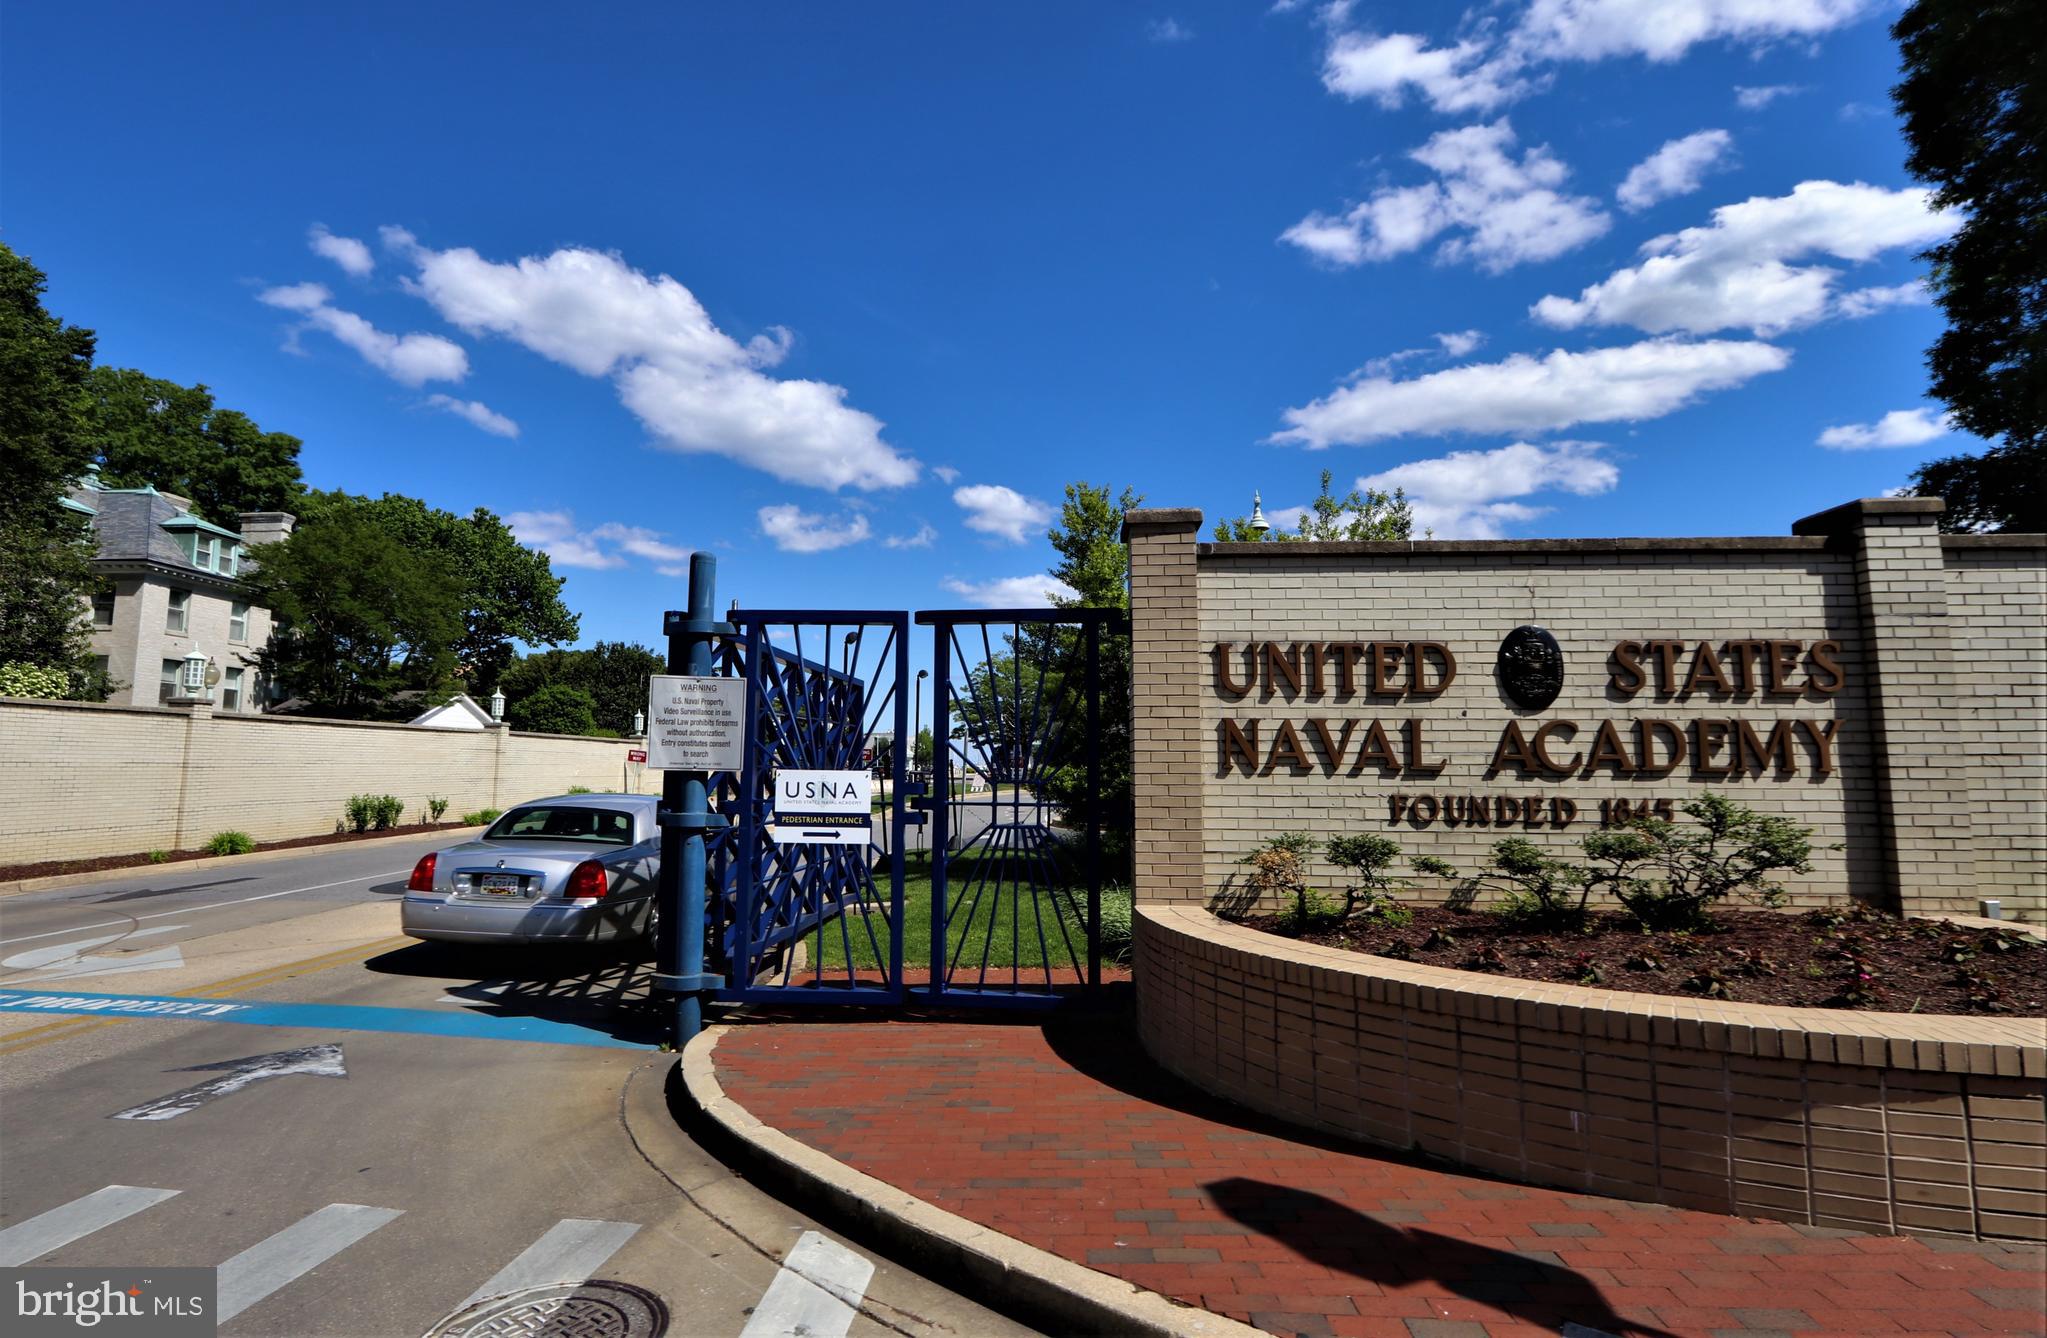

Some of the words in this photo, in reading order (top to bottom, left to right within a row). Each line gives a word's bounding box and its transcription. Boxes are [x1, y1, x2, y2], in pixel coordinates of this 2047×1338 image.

[1216, 641, 1457, 697] UNITED
[1610, 640, 1846, 695] STATES
[680, 683, 718, 692] WARNING
[672, 697, 683, 705] U.S.
[684, 697, 700, 705] Naval
[701, 698, 724, 707] Property
[663, 707, 679, 715] Video
[680, 707, 714, 716] Surveillance
[655, 717, 676, 725] Federal
[677, 718, 688, 726] Law
[690, 719, 715, 727] prohibits
[715, 719, 738, 727] firearms
[666, 728, 688, 736] without
[661, 739, 675, 747] Entry
[677, 740, 708, 748] constitutes
[1220, 717, 1448, 773] NAVAL
[1494, 717, 1846, 775] ACADEMY
[683, 750, 689, 758] to
[785, 781, 858, 799] USNA
[1390, 795, 1577, 824] FOUNDED
[1601, 797, 1675, 825] 1845
[781, 815, 824, 824] PEDESTRIAN
[825, 816, 863, 825] ENTRANCE
